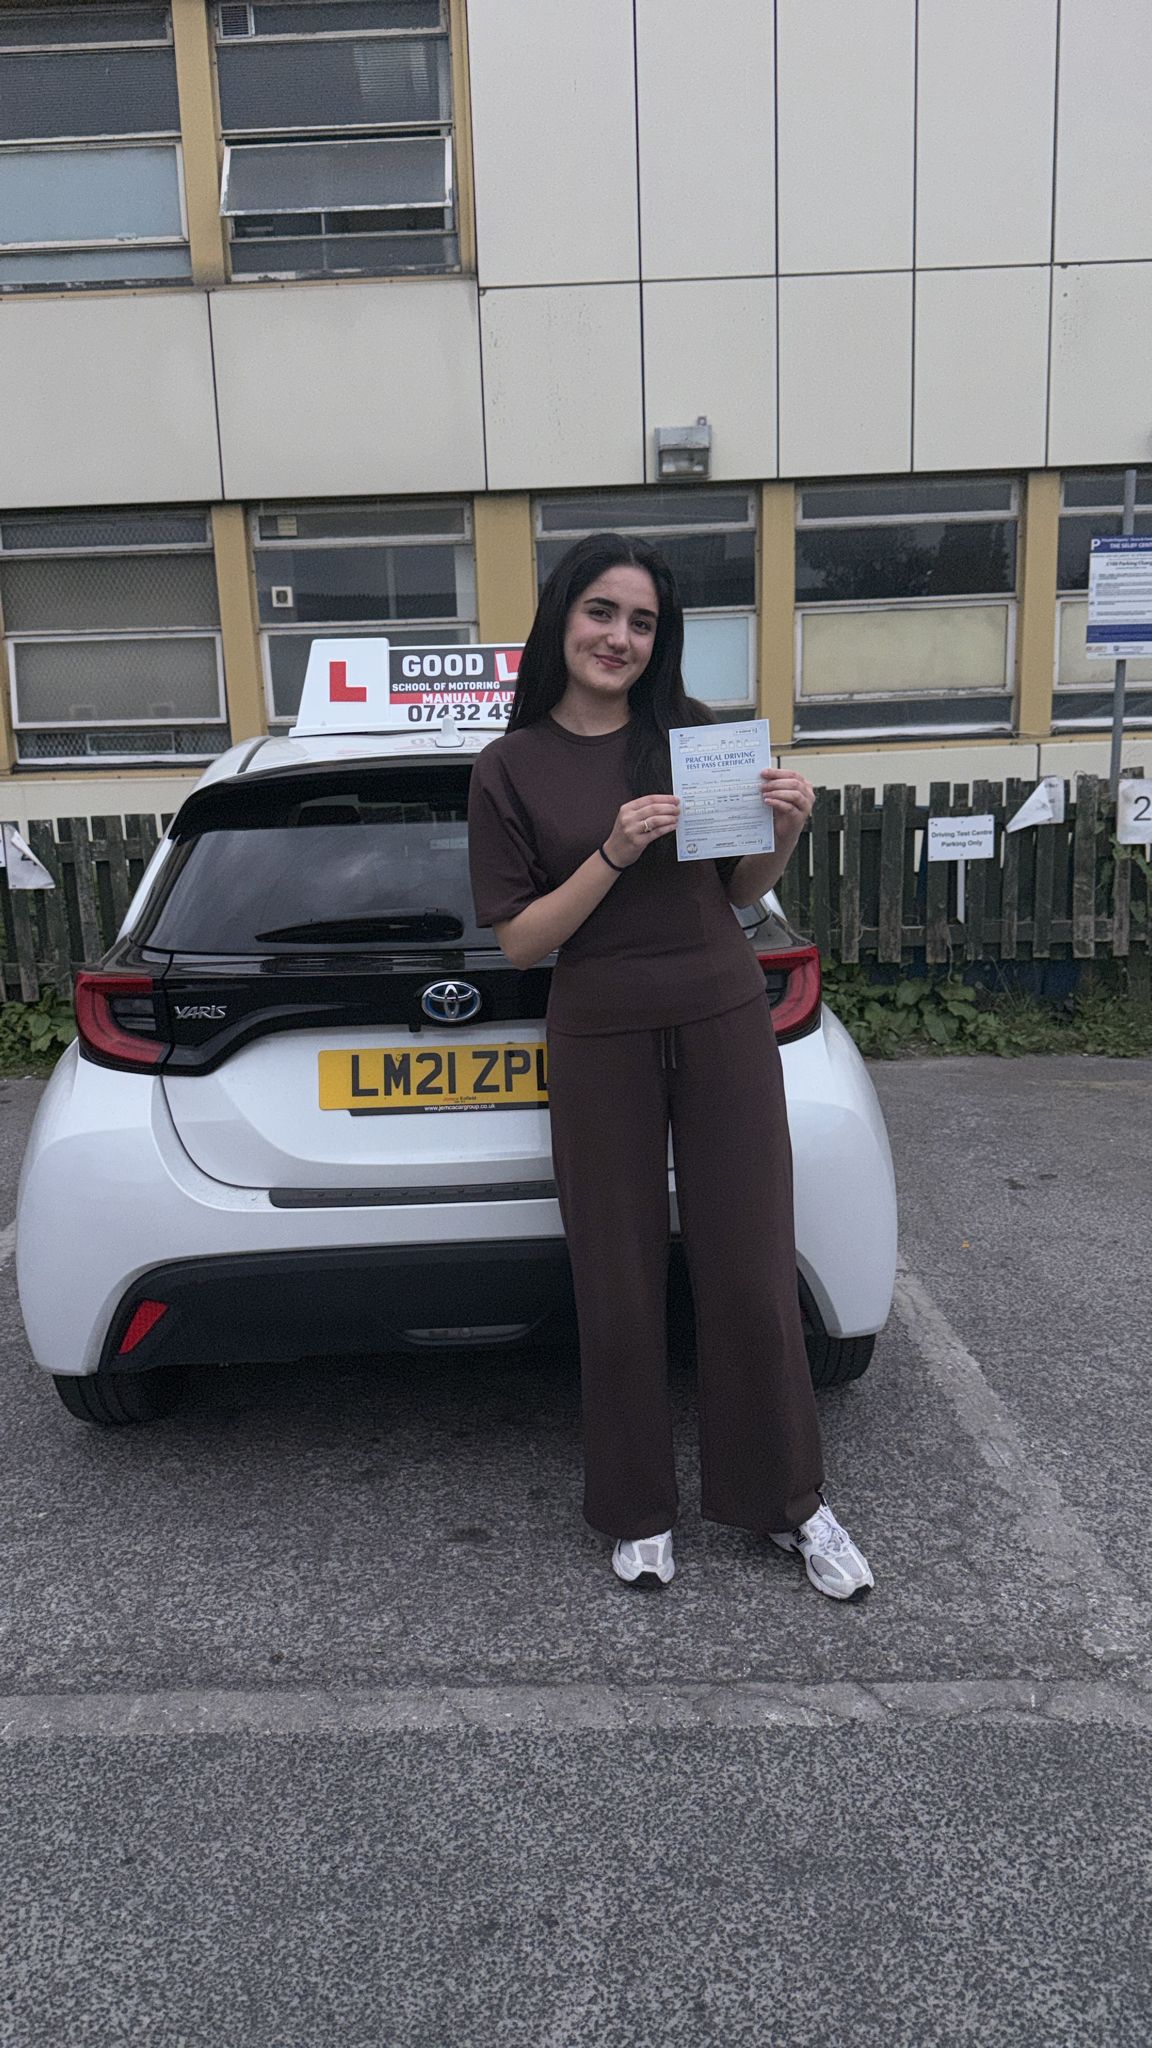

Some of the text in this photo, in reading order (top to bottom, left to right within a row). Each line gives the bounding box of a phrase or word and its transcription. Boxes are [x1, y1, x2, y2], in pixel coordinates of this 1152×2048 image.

[1091, 539, 1101, 551] P
[402, 652, 519, 681] GOOD L
[329, 661, 367, 702] L
[392, 681, 500, 692] SCHOOL OF MOTORING
[422, 692, 479, 704] MANUAL
[408, 704, 480, 722] 07432
[685, 751, 756, 764] PRACTICAL DRIVING
[718, 758, 756, 767] CERTIFICATE
[1133, 796, 1152, 821] 2
[174, 1004, 228, 1019] YARIS
[351, 1051, 456, 1097] LM21
